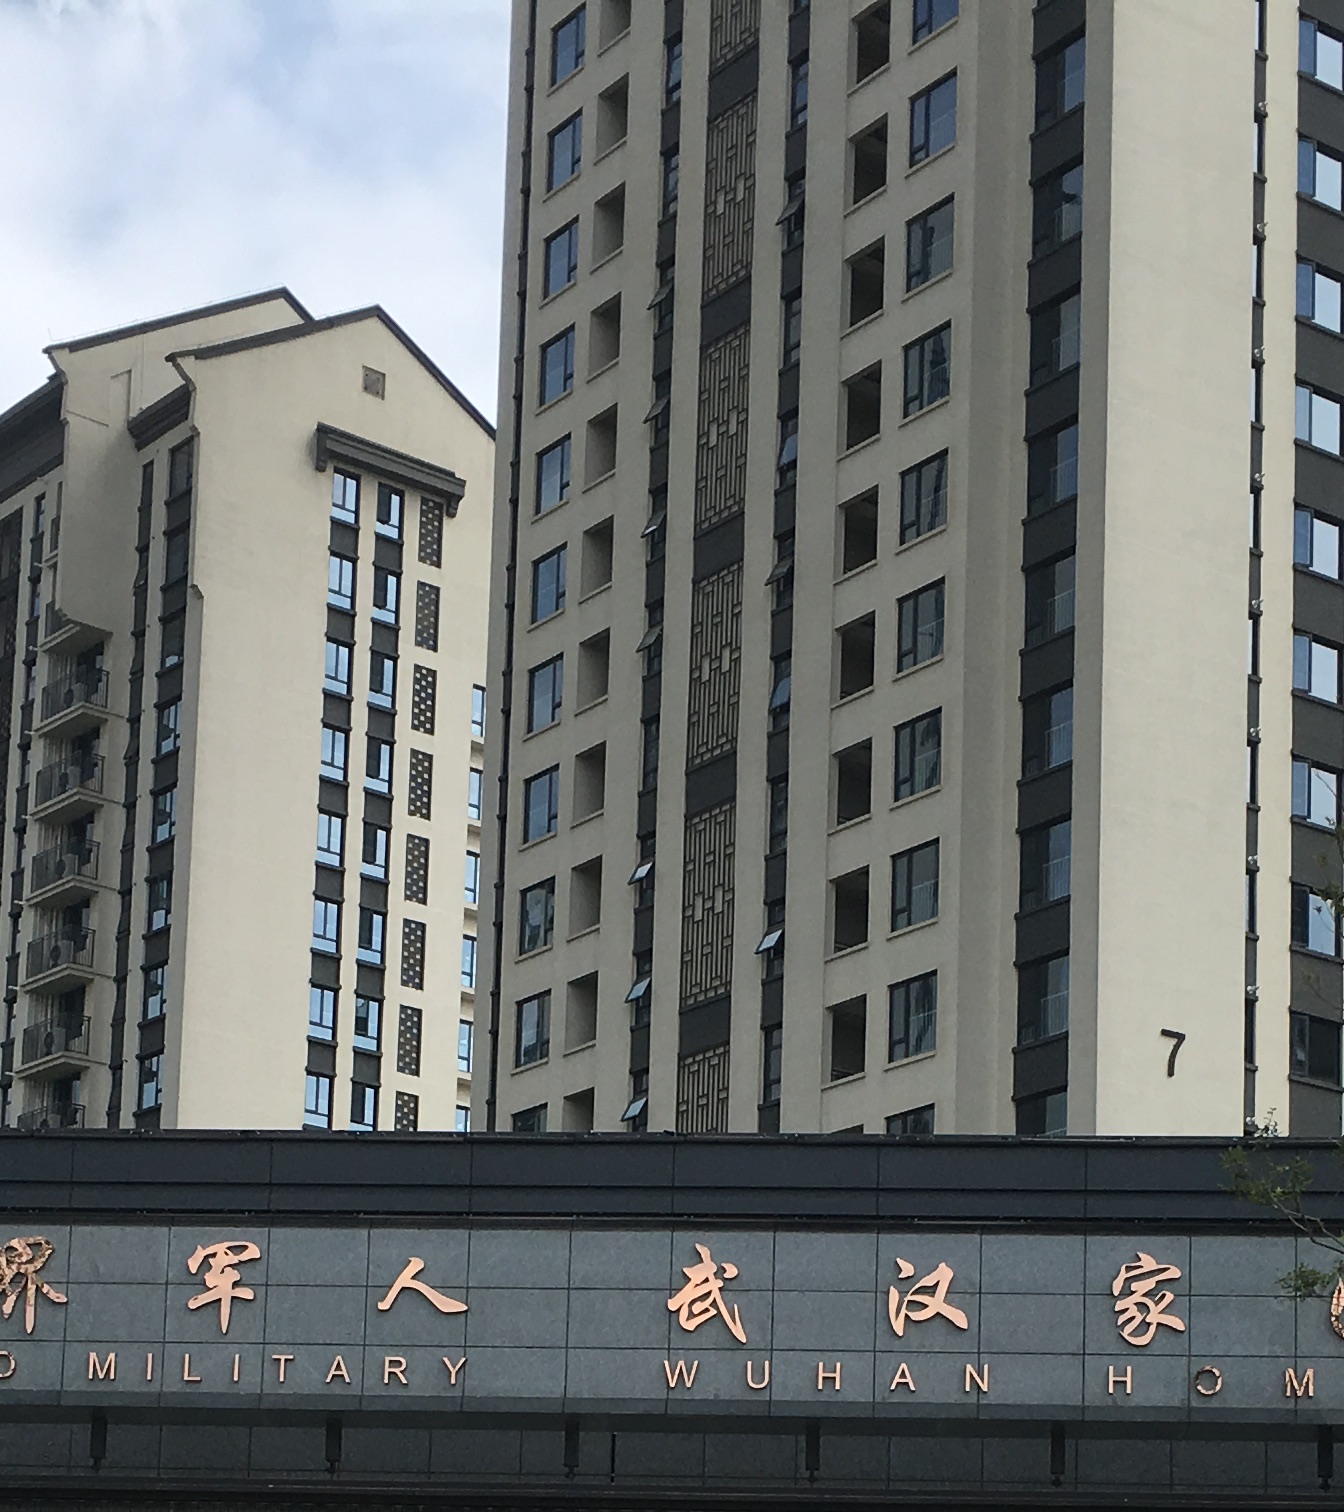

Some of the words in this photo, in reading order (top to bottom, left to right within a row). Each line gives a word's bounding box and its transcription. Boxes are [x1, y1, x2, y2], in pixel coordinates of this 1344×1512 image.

[1160, 1028, 1186, 1078] 7
[88, 1351, 467, 1386] MILITARY
[663, 1359, 990, 1393] WUHAN
